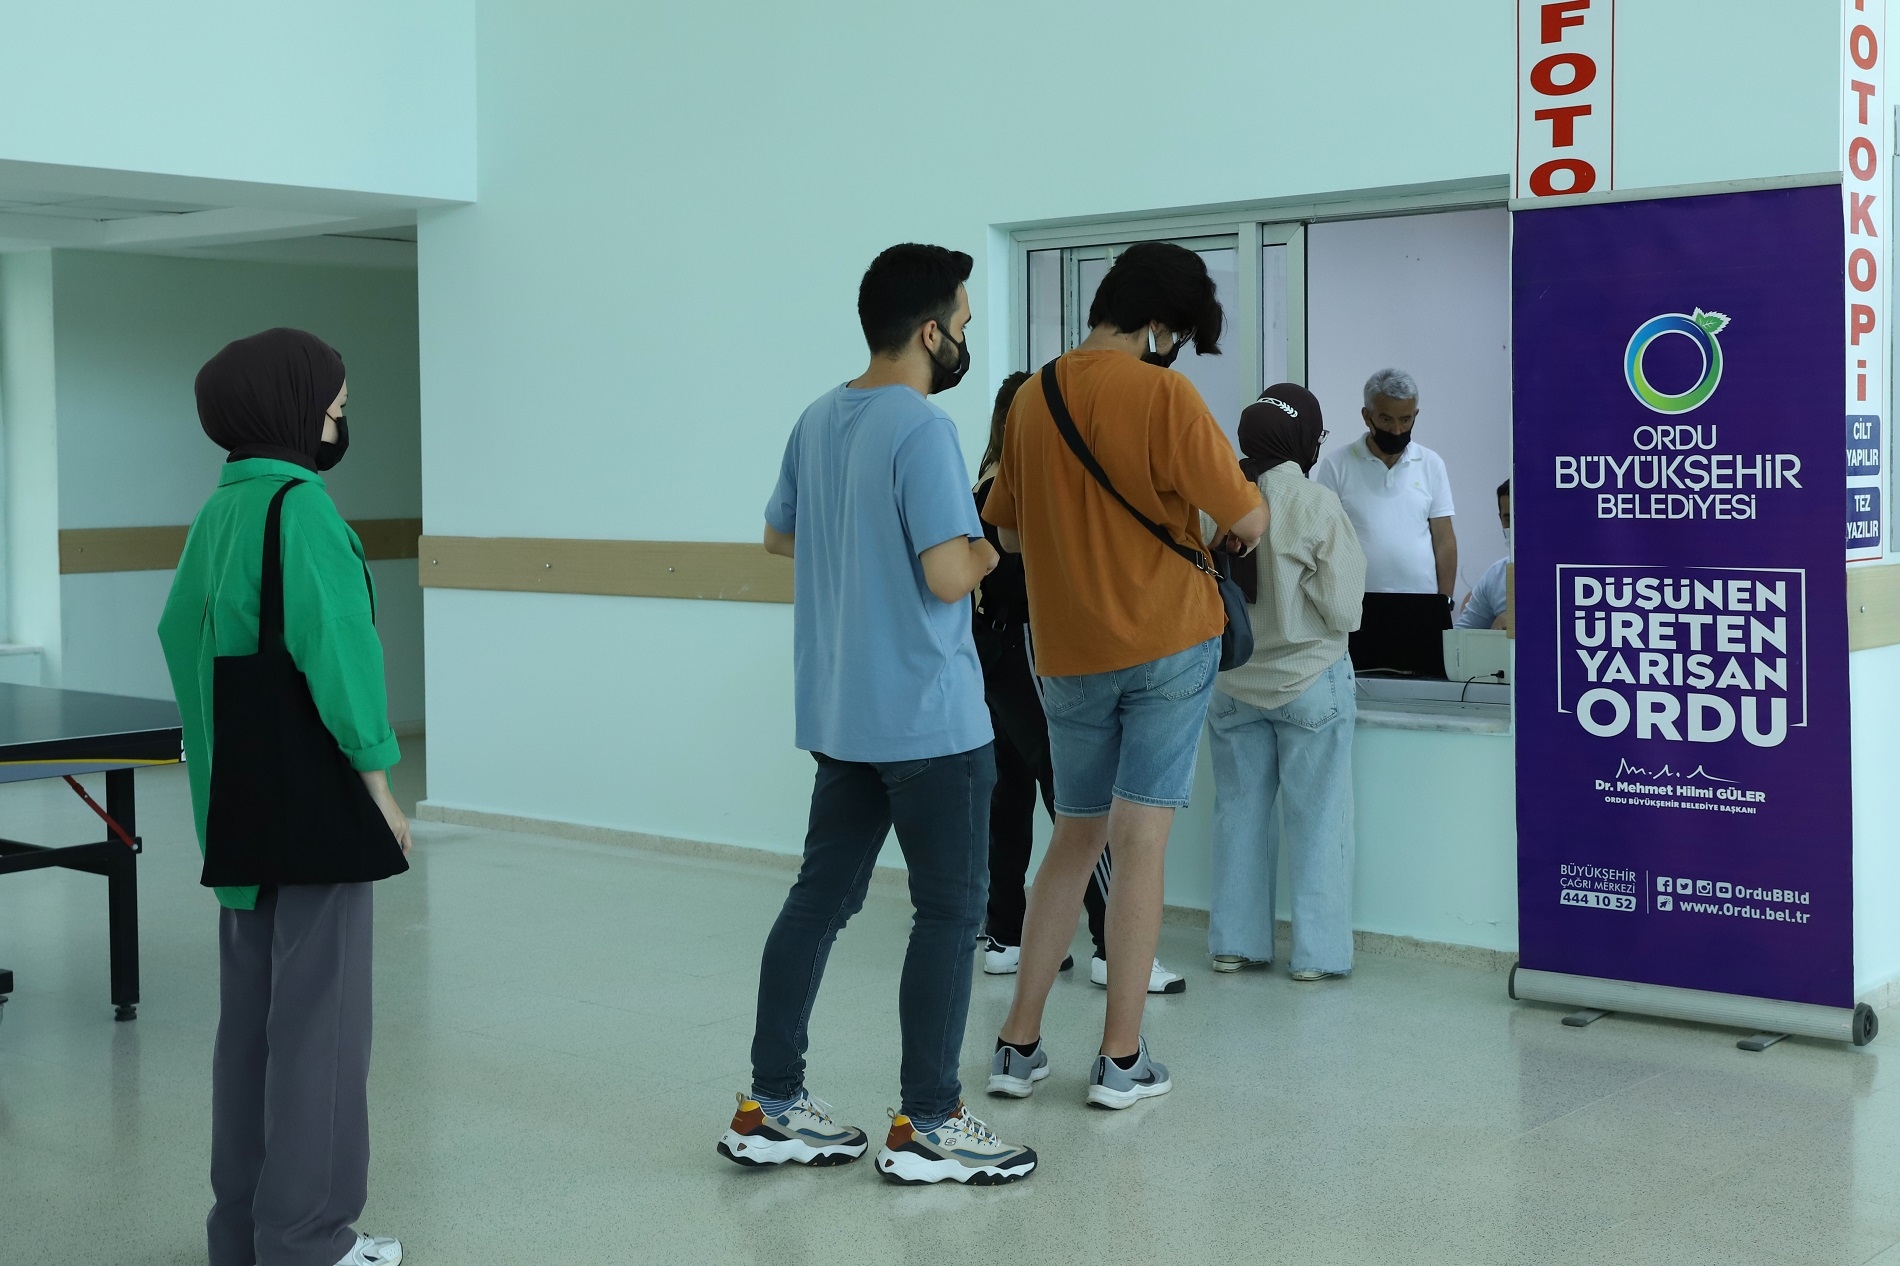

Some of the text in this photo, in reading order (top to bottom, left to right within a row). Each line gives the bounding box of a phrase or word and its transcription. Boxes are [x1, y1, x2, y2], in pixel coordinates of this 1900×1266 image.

[1529, 0, 1597, 198] FOTO
[1849, 0, 1878, 402] OTOKOPİ
[1633, 424, 1717, 450] ORDU
[1853, 417, 1872, 440] CİLT
[1846, 448, 1879, 467] YAPILIR
[1555, 453, 1803, 492] BÜYÜKŞEHİR
[1597, 494, 1756, 520] BELEDİYESİ
[1854, 494, 1871, 512] TEZ
[1847, 520, 1879, 540] YAZILIR
[1574, 576, 1787, 613] DÜŞÜNEN
[1575, 611, 1787, 655] ÜRETEN
[1576, 650, 1788, 692] YARIŞAN
[1576, 687, 1788, 748] ORDU
[1595, 779, 1766, 803] Dr. Mehmet Hilmi GÜLER
[1604, 796, 1757, 815] ORDU BÜYÜKŞEHİR BELEDİYE BAŞKANI
[1559, 876, 1636, 894] ÇAĞRI MERKEZİ
[1560, 862, 1636, 883] BÜYÜKŞEHİR
[1562, 892, 1633, 910] 444 10 52
